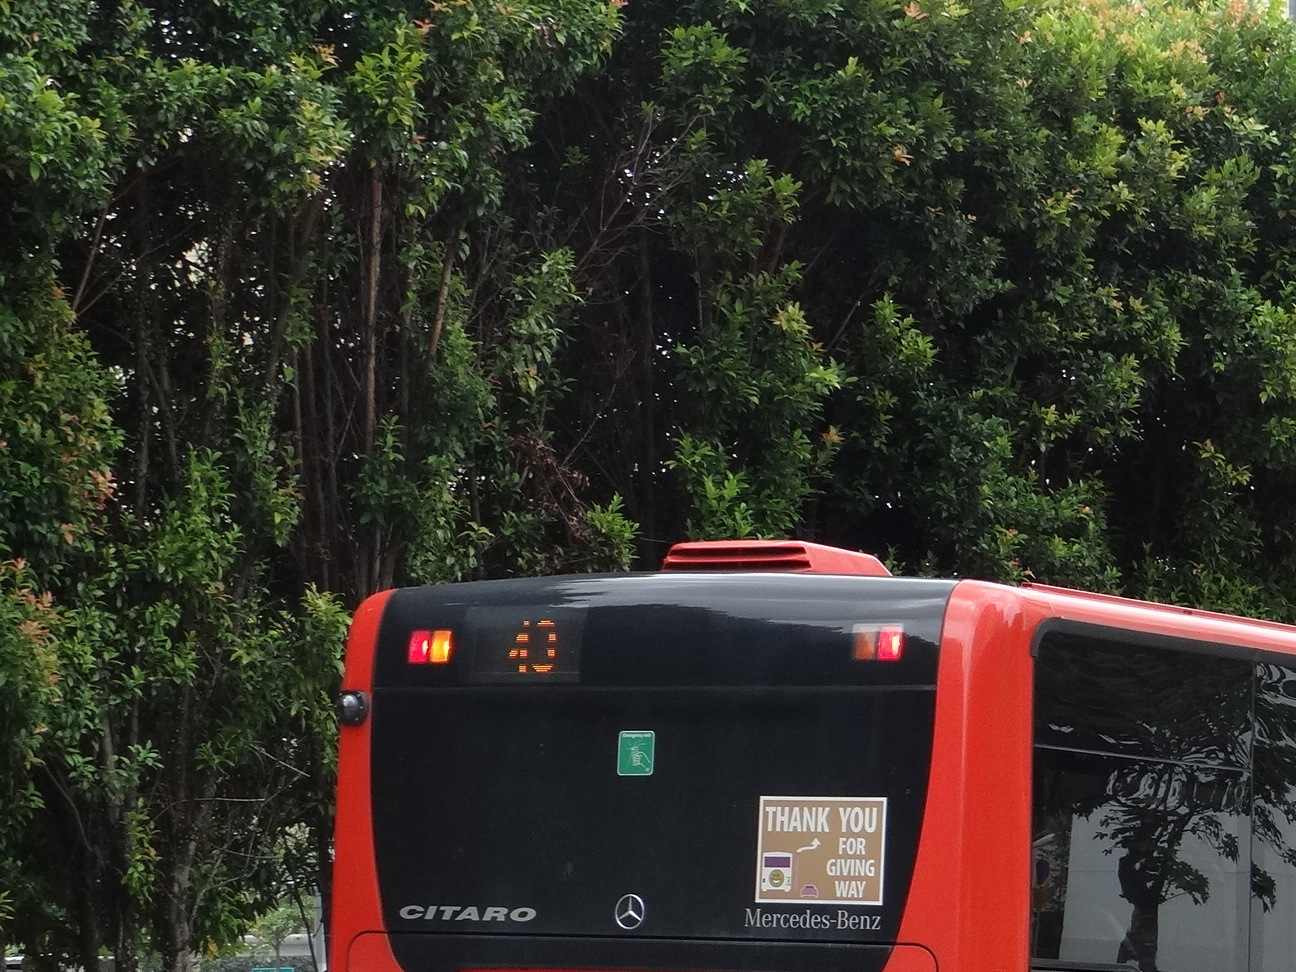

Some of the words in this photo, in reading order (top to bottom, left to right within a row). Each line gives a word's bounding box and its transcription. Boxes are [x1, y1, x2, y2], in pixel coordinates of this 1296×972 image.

[766, 806, 831, 833] THANK
[839, 806, 878, 832] YOU
[838, 837, 866, 855] FOR
[826, 859, 875, 877] GIVING
[835, 880, 867, 898] WAY
[399, 905, 537, 922] CITARO
[744, 908, 881, 930] Mercedes-Benz
